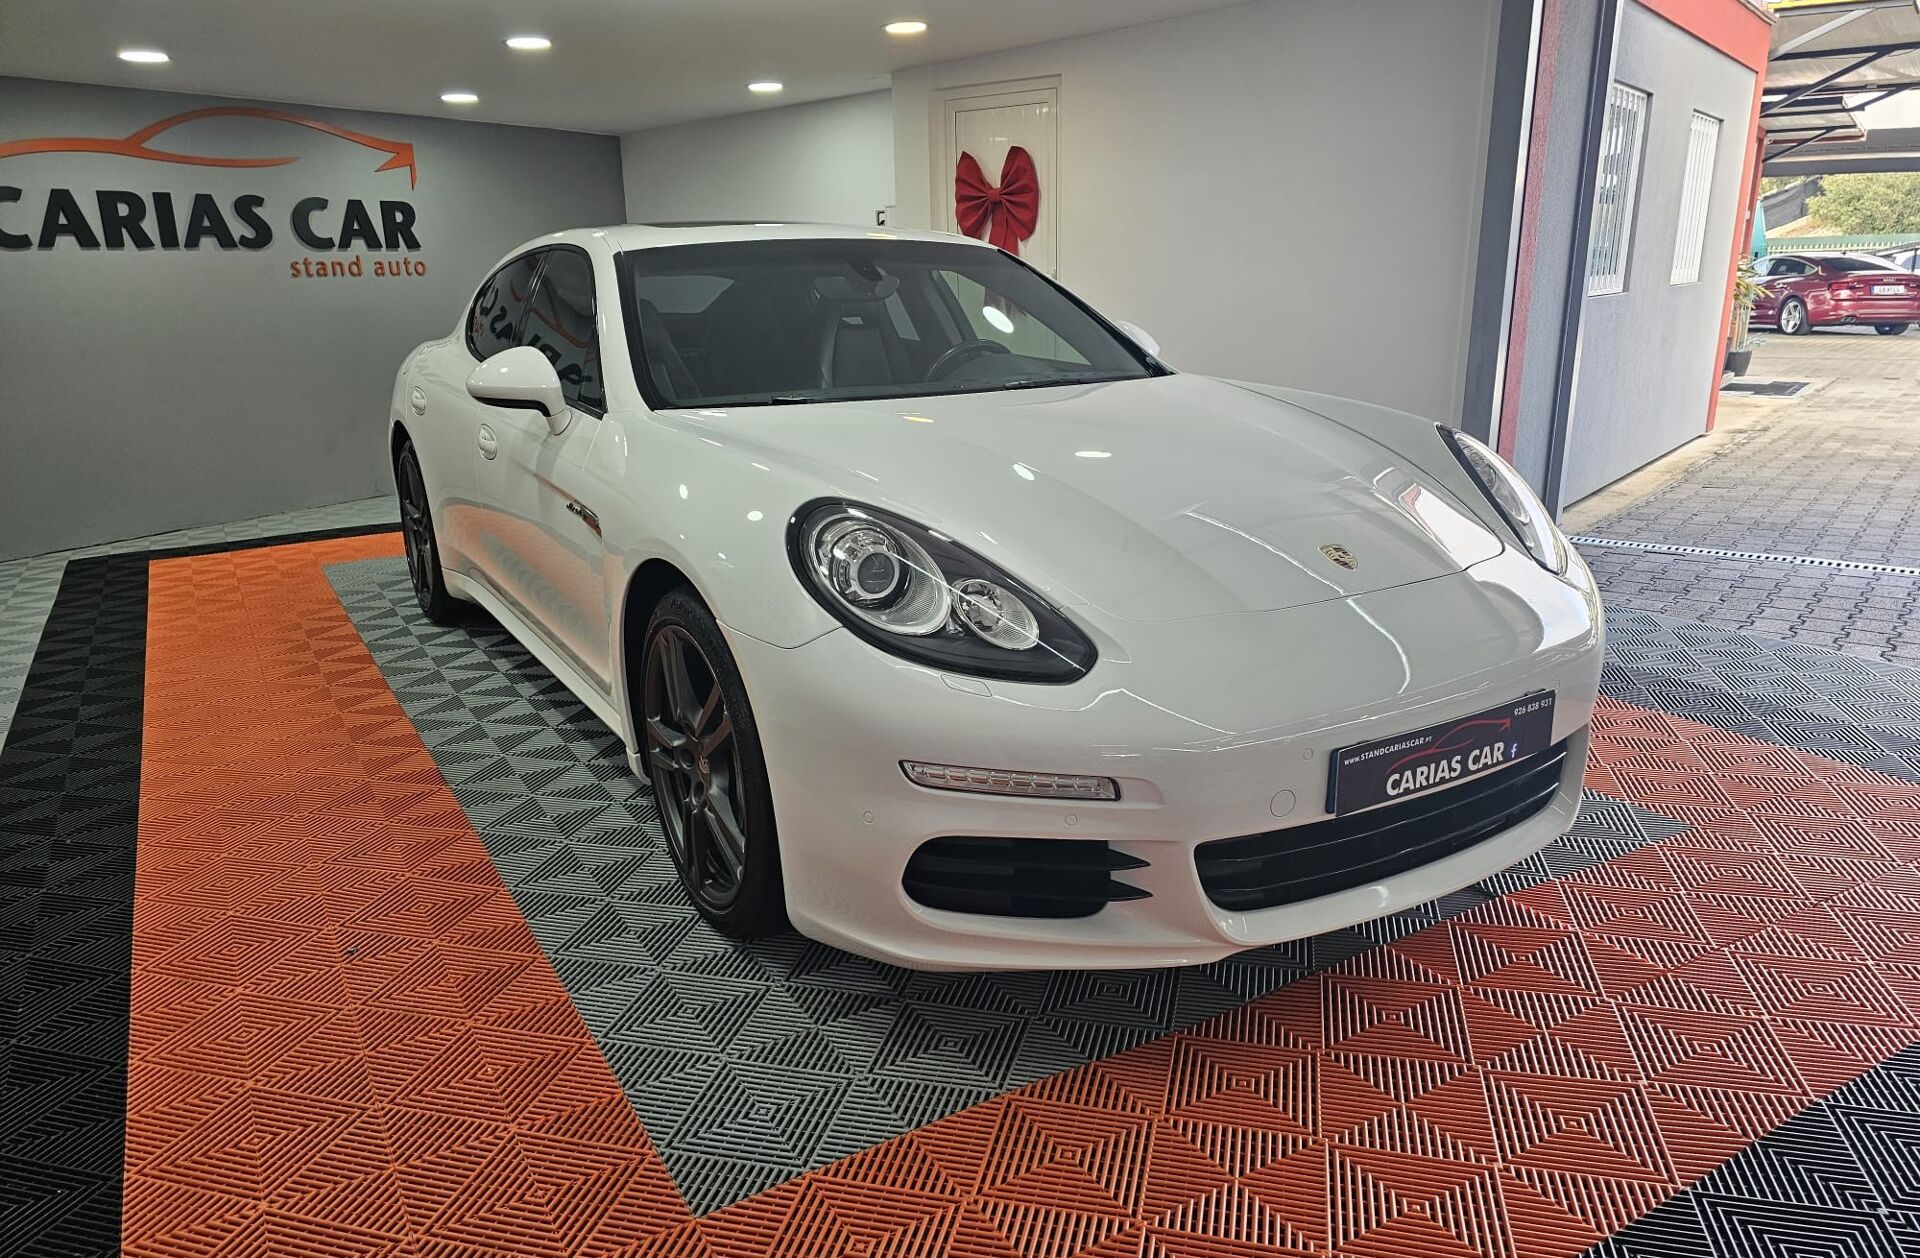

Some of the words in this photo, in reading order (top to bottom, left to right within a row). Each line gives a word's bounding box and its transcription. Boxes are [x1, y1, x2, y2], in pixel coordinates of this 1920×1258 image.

[0, 185, 273, 249] CARIAS
[292, 197, 421, 250] CAR
[290, 255, 363, 278] stand
[374, 256, 427, 277] auto
[1514, 706, 1526, 716] 926
[1527, 702, 1540, 712] 838
[1541, 698, 1552, 708] 931
[1386, 756, 1462, 796] CARIAS
[1468, 742, 1505, 771] CAR
